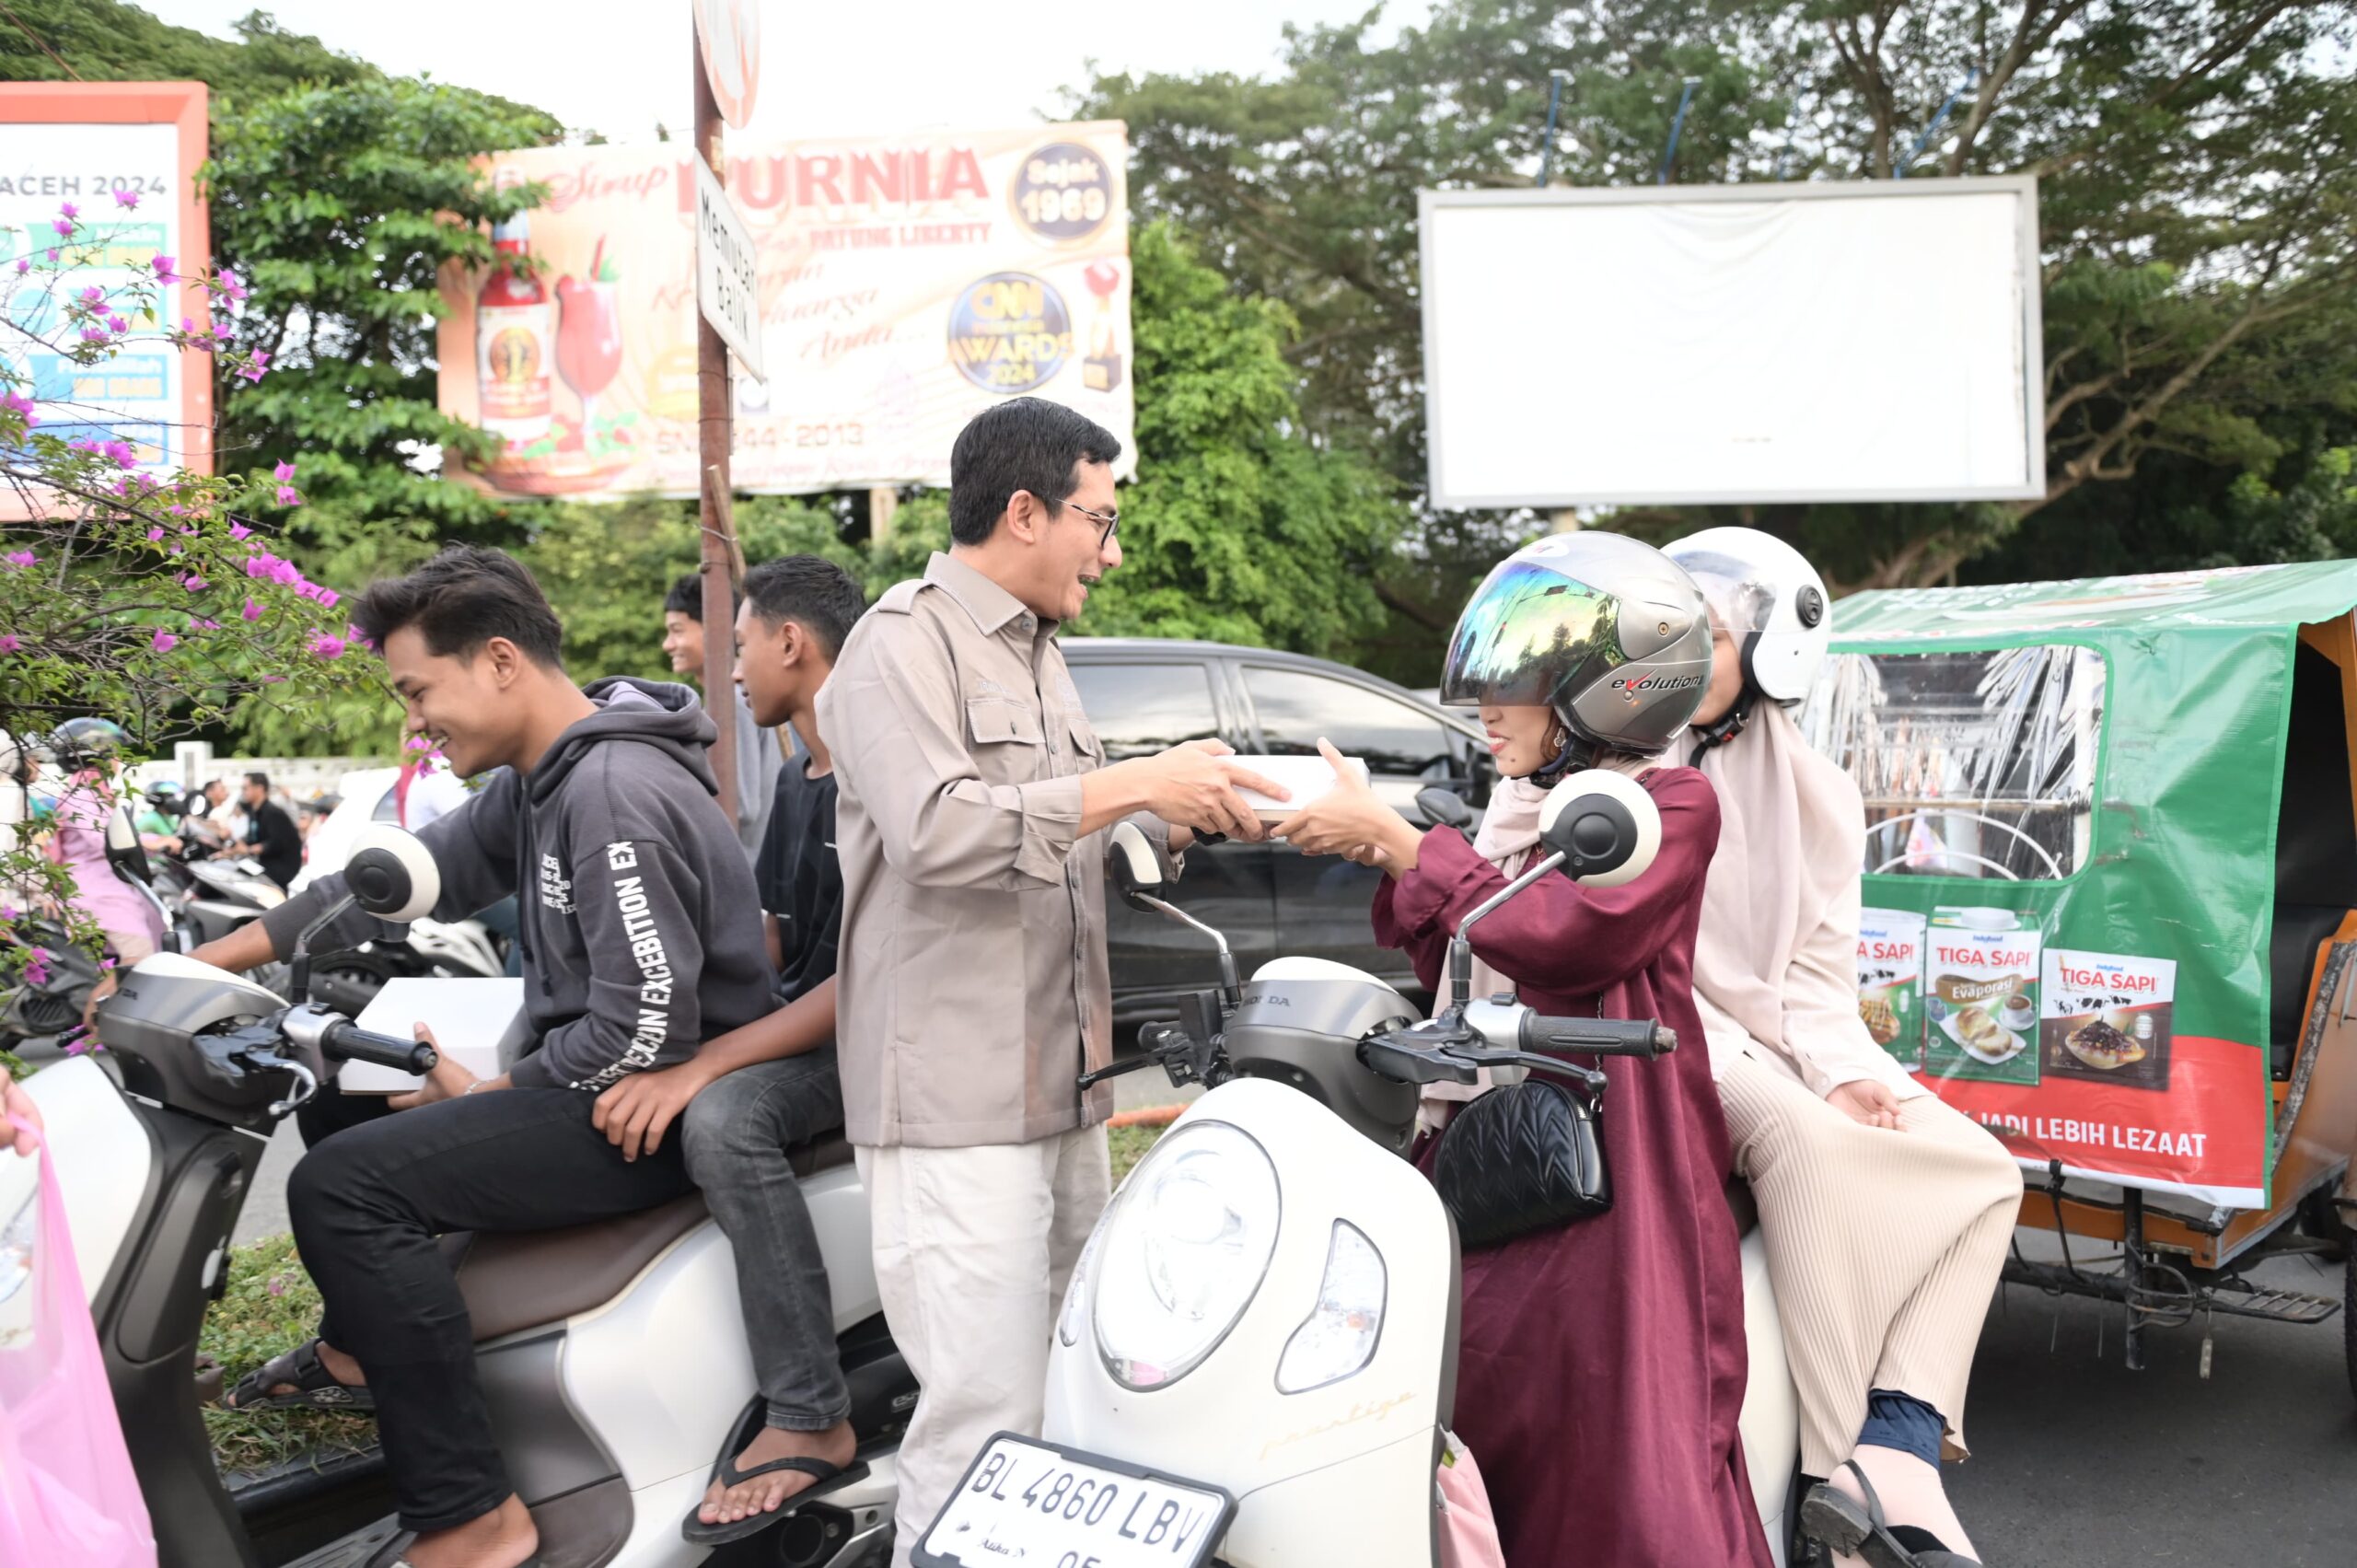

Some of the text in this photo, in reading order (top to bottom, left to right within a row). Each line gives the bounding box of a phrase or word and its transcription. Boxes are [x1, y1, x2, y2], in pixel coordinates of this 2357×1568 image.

[0, 176, 167, 196] ACEH 2024
[1027, 157, 1100, 187] Sejak
[1021, 188, 1106, 223] 1969
[899, 221, 993, 248] LIBERTY
[716, 265, 749, 344] Balik
[970, 281, 1045, 320] CNN
[948, 331, 1076, 363] AWARDS
[614, 876, 674, 1005] EXCEBITION
[1873, 942, 1914, 960] SAPI
[1936, 947, 2031, 967] TIGA SAPI
[1952, 977, 2014, 1000] Evaporasi
[2061, 967, 2156, 993] TIGA SAPI
[2036, 1116, 2106, 1146] LEBIH
[2112, 1125, 2208, 1158] LEZAAT
[970, 1452, 1018, 1502] BL
[1021, 1468, 1120, 1527] 4860
